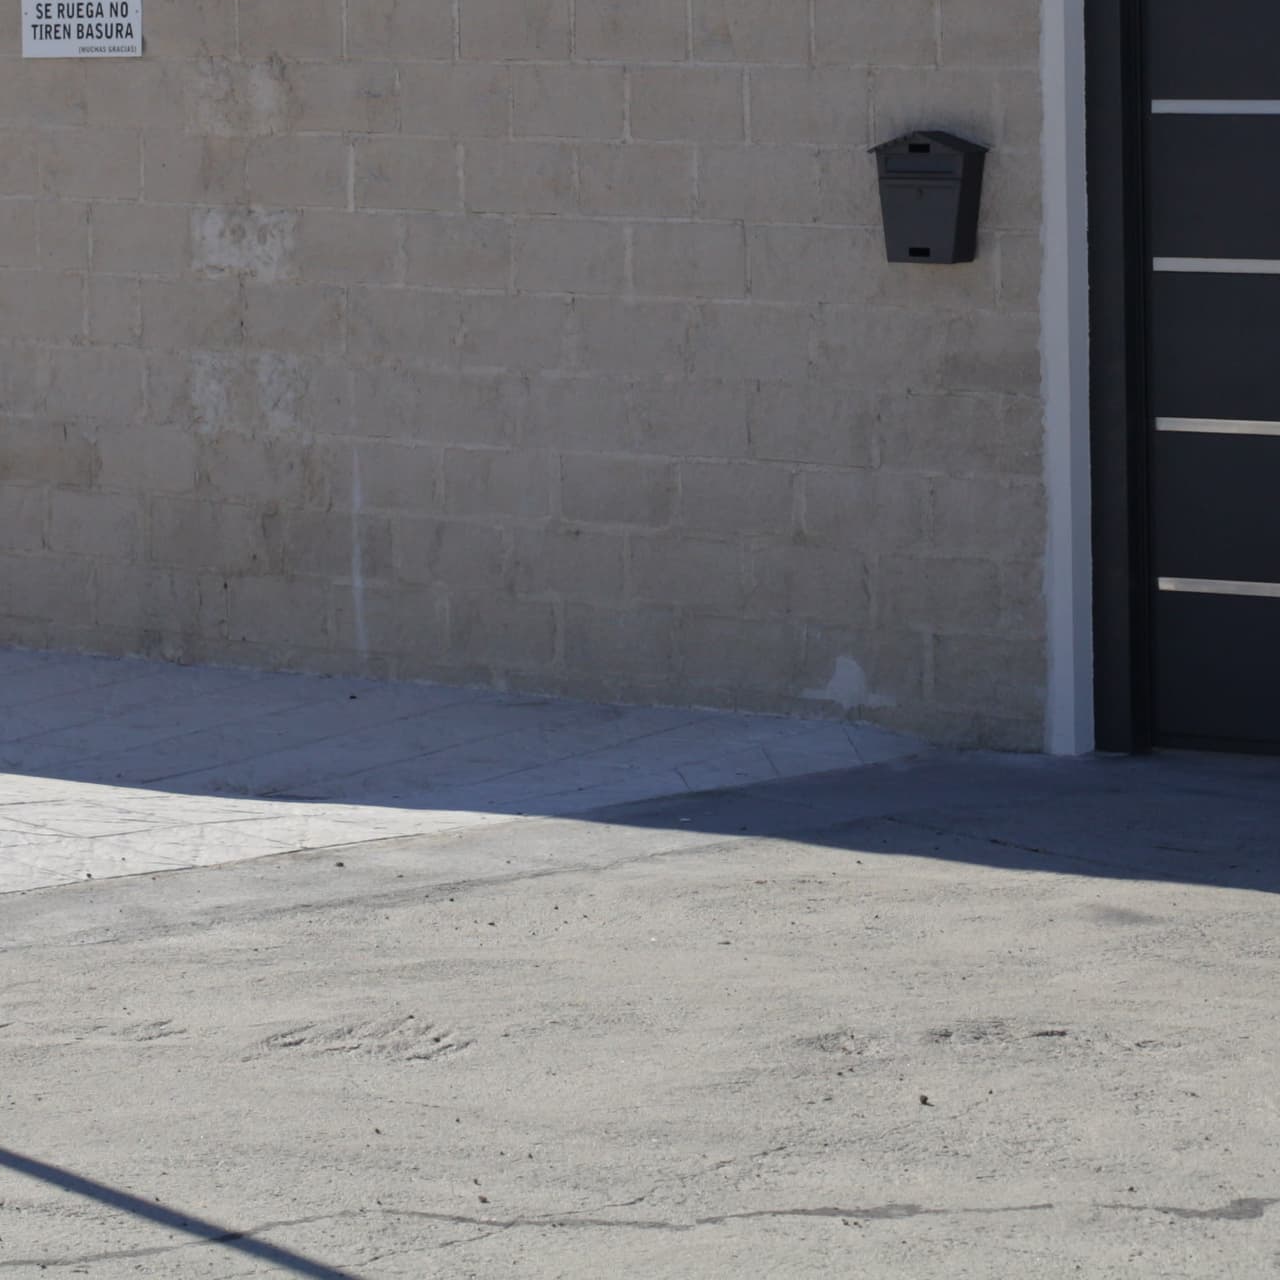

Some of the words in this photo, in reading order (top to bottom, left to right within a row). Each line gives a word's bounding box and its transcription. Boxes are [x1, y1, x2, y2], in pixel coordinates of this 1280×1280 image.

[35, 3, 52, 19] SE
[57, 2, 104, 19] RUEGA
[110, 1, 129, 18] NO
[31, 24, 71, 40] TIREN
[76, 22, 134, 39] BASURA
